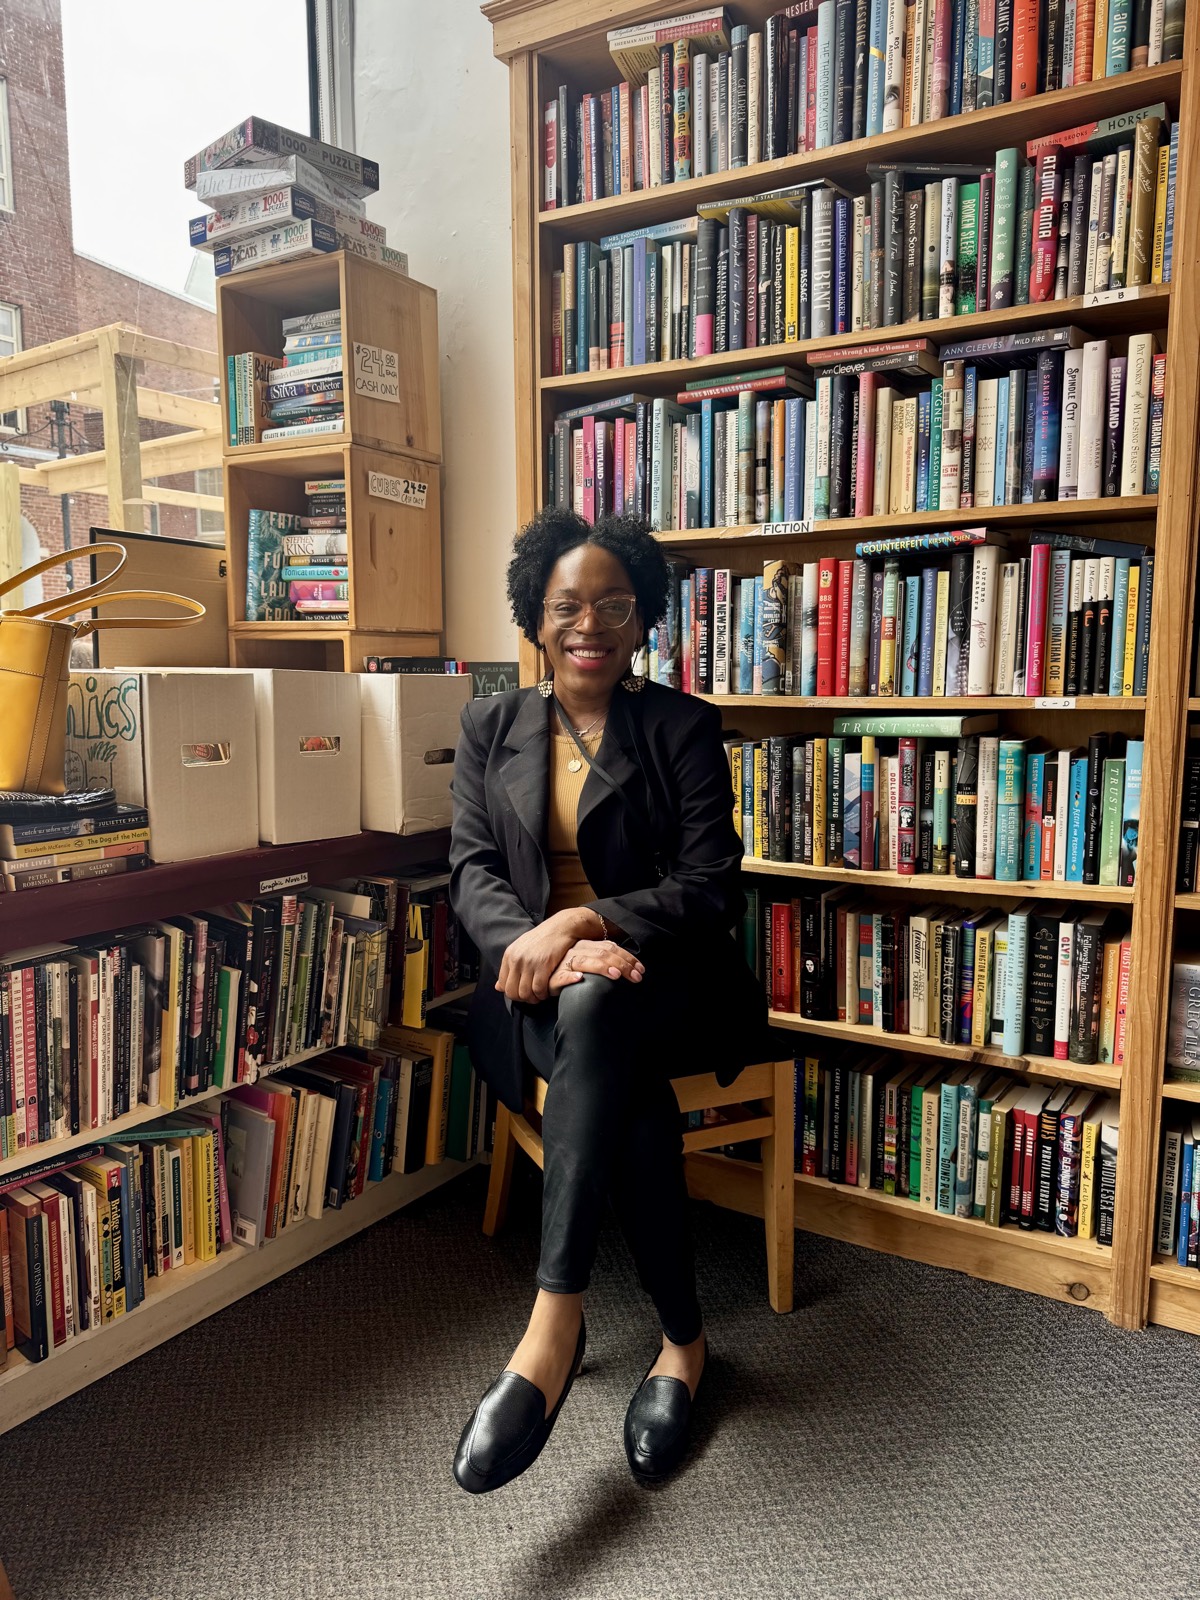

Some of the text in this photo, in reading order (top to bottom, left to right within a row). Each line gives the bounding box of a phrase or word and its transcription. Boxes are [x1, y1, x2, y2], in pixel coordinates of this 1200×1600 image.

[786, 1, 814, 17] HESTER
[998, 0, 1010, 34] SAINTS
[614, 34, 654, 47] SHERMAN ALEXIE
[1016, 8, 1026, 70] ALLENDE
[1112, 13, 1128, 59] BIG SKY
[818, 41, 830, 132] THE THROWBACK LIST
[677, 66, 686, 158] CHAIN-GANG ALL-STARS
[1108, 110, 1150, 131] HORSE
[1030, 130, 1088, 151] GERALDINE BROOKS
[280, 134, 361, 174] 1000 PUZZLE
[262, 191, 284, 212] 1000
[268, 200, 289, 212] PUZZLE
[814, 201, 832, 210] LEIGH
[1038, 156, 1056, 238] ATOMIC ANNA
[284, 224, 304, 244] 1000
[289, 233, 310, 244] PUZZLE
[359, 220, 380, 236] 1000
[366, 232, 385, 244] PUZZLE
[908, 204, 918, 268] SAVING SOPHIE
[960, 198, 976, 255] BROKEN SLEEP
[240, 245, 258, 259] CATS
[347, 239, 368, 258] CATS
[380, 246, 402, 264] 1000
[387, 258, 406, 270] PUZZLE
[747, 230, 756, 321] PELICAN ROAD
[813, 224, 831, 311] HELL BENT
[800, 268, 808, 302] PASSAGE
[1092, 295, 1099, 304] A
[944, 335, 1046, 355] ANN CLEEVES WILD FIRE
[270, 368, 310, 382] Hamlet's Children
[312, 380, 340, 393] Collector
[385, 370, 398, 379] EACH
[274, 382, 298, 398] Silva
[355, 377, 398, 397] CASH ONLY
[1042, 374, 1050, 406] SANDRA
[1066, 368, 1080, 421] SPINDLE CITY
[1108, 366, 1122, 428] BEAUTYLAND
[1130, 344, 1146, 474] PAT CONROY MY LOSING SEASON
[1150, 359, 1166, 472] UNBOUND TARANA BURKE
[1041, 410, 1049, 439] BROWN
[370, 474, 400, 498] CUBES
[412, 497, 424, 505] ONLY
[286, 536, 315, 544] STEPHEN
[764, 522, 810, 534] FICTION
[286, 544, 315, 555] KING
[862, 534, 971, 554] COUNTERFEIT KIRSTIN CHEN
[856, 563, 866, 628] WILEY CASH
[1128, 586, 1136, 633] OPEN CITY
[1050, 564, 1066, 680] BOURNVILLE JONATHAN COE
[1031, 641, 1041, 680] Lynn Coady
[842, 722, 900, 734] TRUST
[1005, 758, 1014, 802] DESERTER
[1108, 768, 1118, 814] TRUST
[956, 796, 976, 804] FAITH
[98, 819, 126, 827] JULIETTE
[24, 842, 72, 854] Elizabeth McKenzie
[132, 832, 148, 840] North
[10, 859, 52, 870] NINE LIVES
[88, 862, 113, 871] GALLOWS
[22, 878, 54, 888] ROBINSON
[28, 873, 48, 882] PETER
[260, 874, 308, 891] Graphic Novels
[282, 930, 292, 986] MIGHTY AVENGERS
[978, 937, 986, 972] WASHINGTON
[1060, 936, 1070, 966] GLYPH
[942, 940, 954, 1024] THE BLACK BOOK
[1184, 986, 1200, 1066] GREG ILES
[26, 986, 36, 1091] ARMAGEDDONQUEST
[925, 1100, 934, 1126] today
[940, 1090, 952, 1181] JANET EVANOVICH GOING
[924, 1147, 933, 1172] home
[1040, 1112, 1056, 1212] JAMES PERCIVAL EVERETT
[1166, 1138, 1178, 1187] THE PROPHETS
[1100, 1160, 1116, 1212] MIDDLESEX
[110, 1198, 124, 1281] Bridge Dummies
[33, 1262, 42, 1307] OPENINGS
